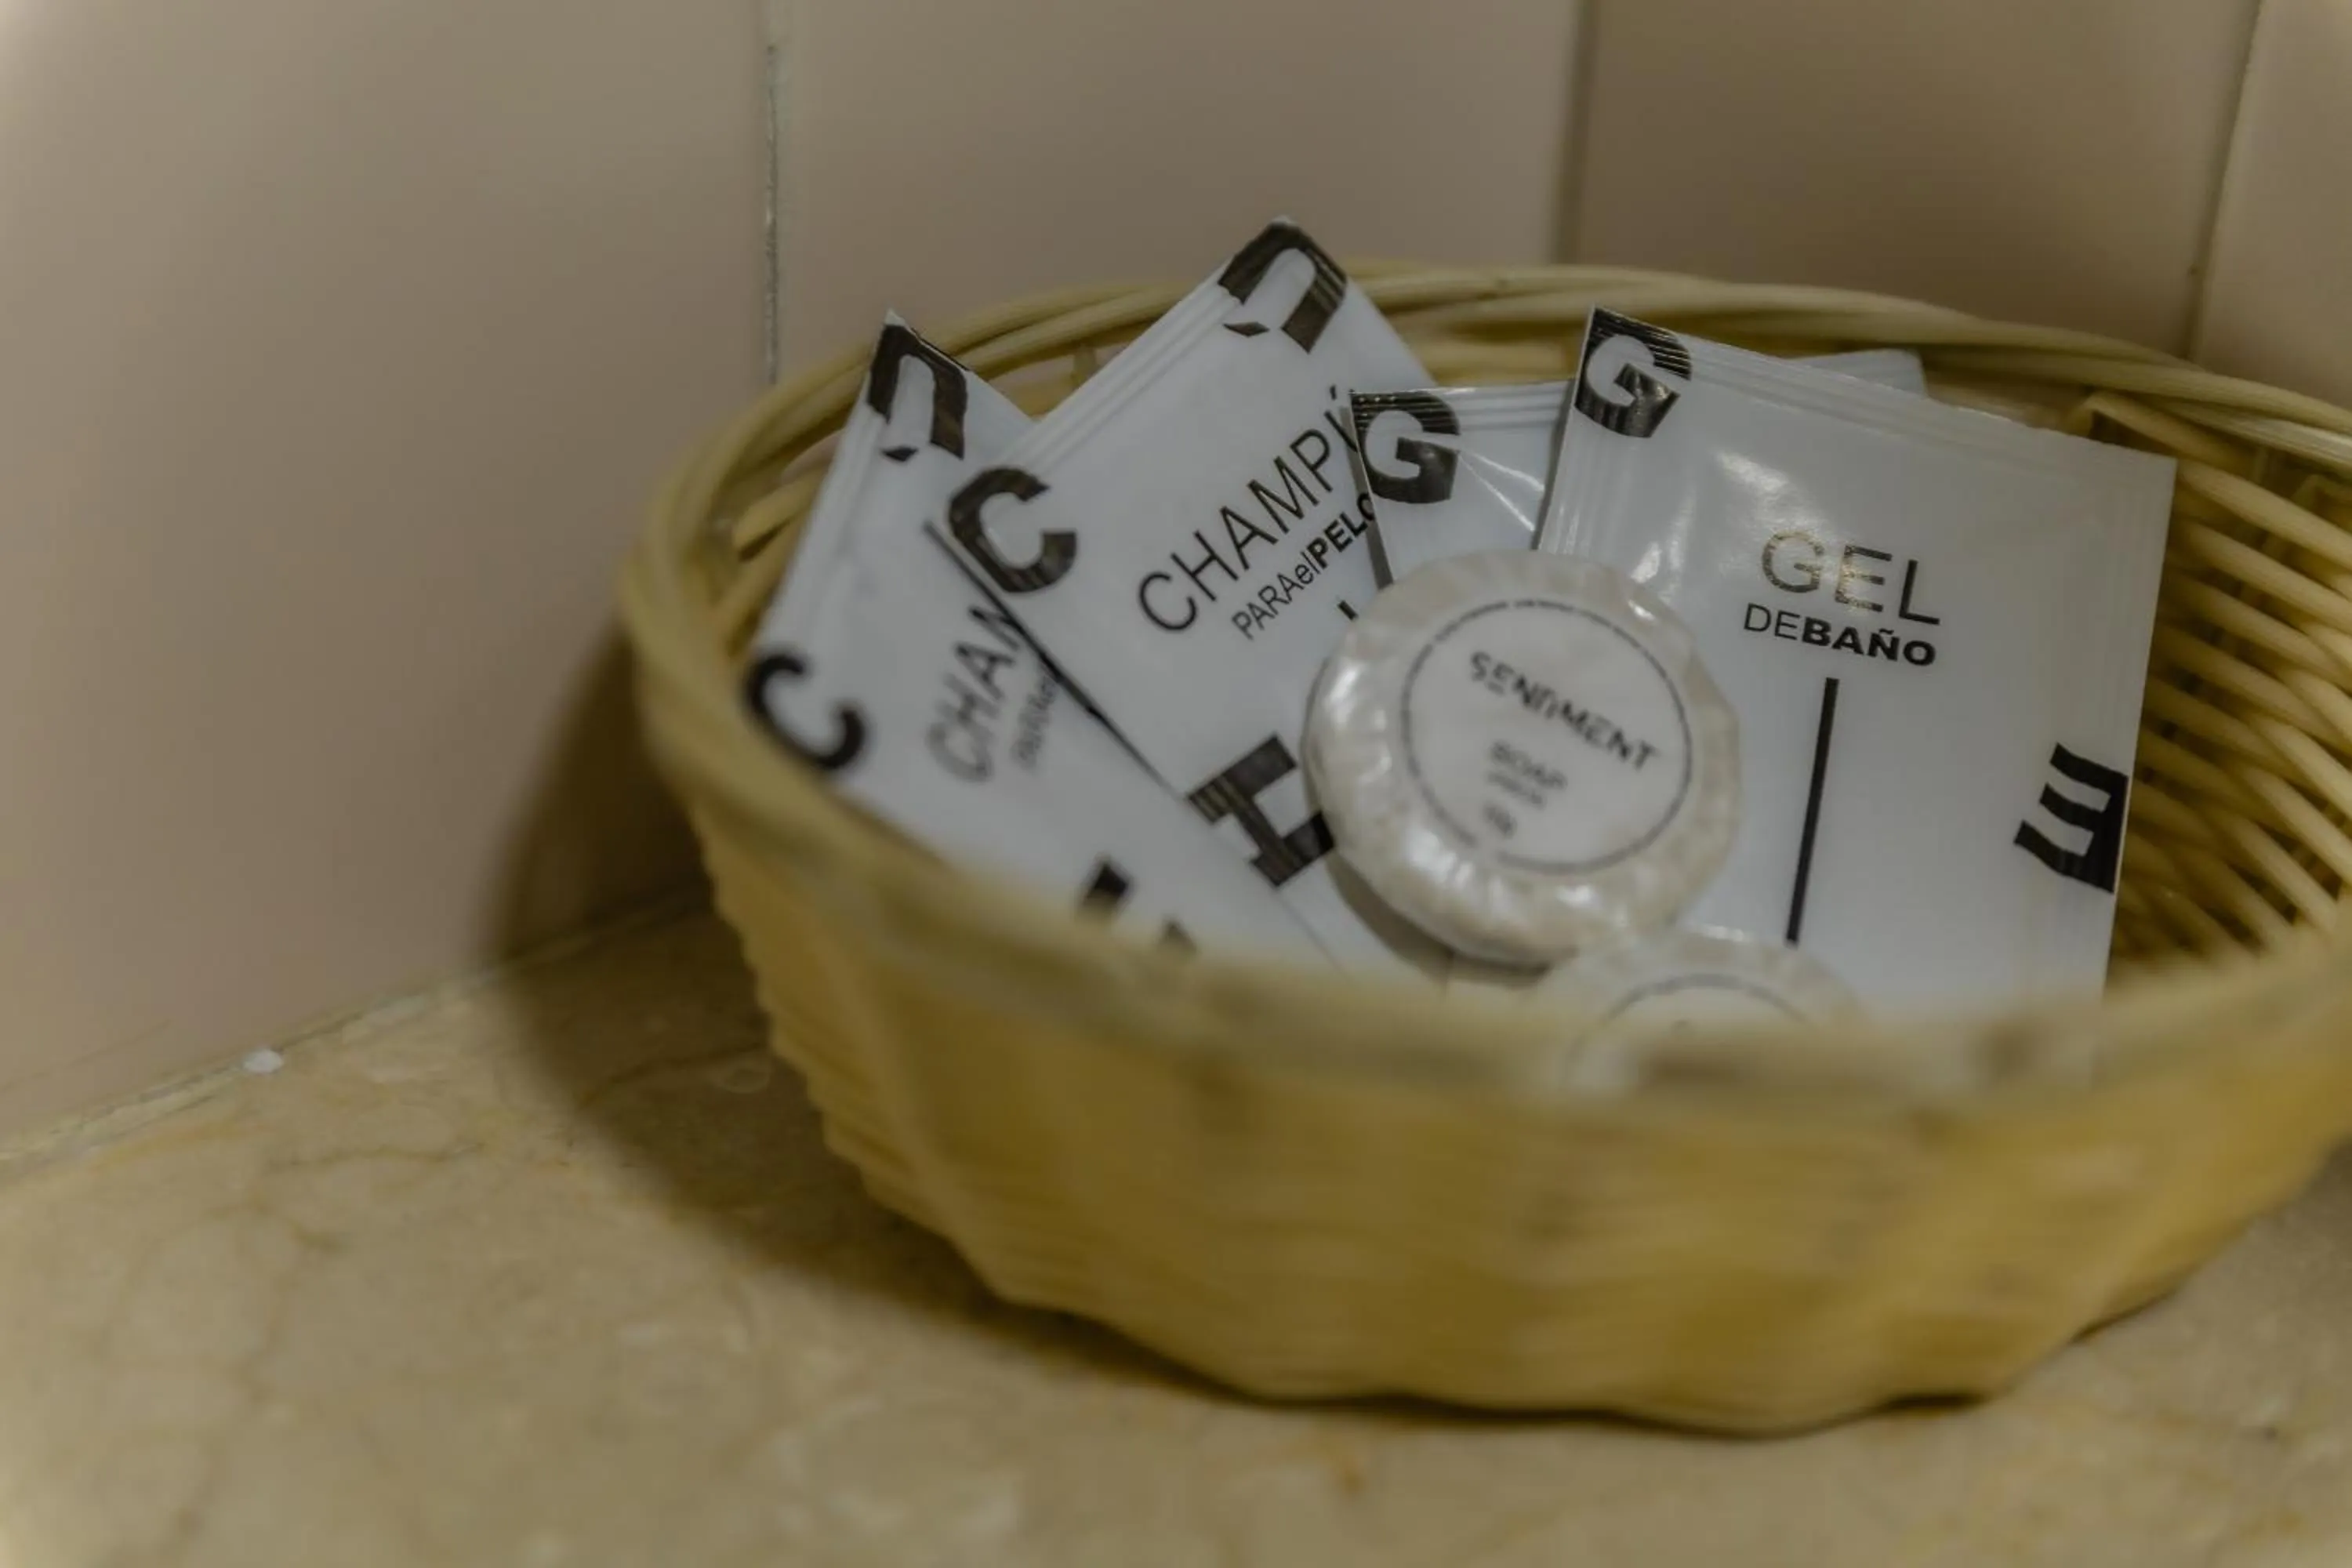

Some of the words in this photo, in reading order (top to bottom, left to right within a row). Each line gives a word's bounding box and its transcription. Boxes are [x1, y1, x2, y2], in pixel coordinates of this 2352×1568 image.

[1574, 307, 1692, 437] G
[1351, 390, 1461, 504] G
[949, 466, 1077, 593] C
[1762, 531, 1941, 626] GEL
[745, 652, 869, 773] C
[1471, 652, 1661, 771] SENTIMENT
